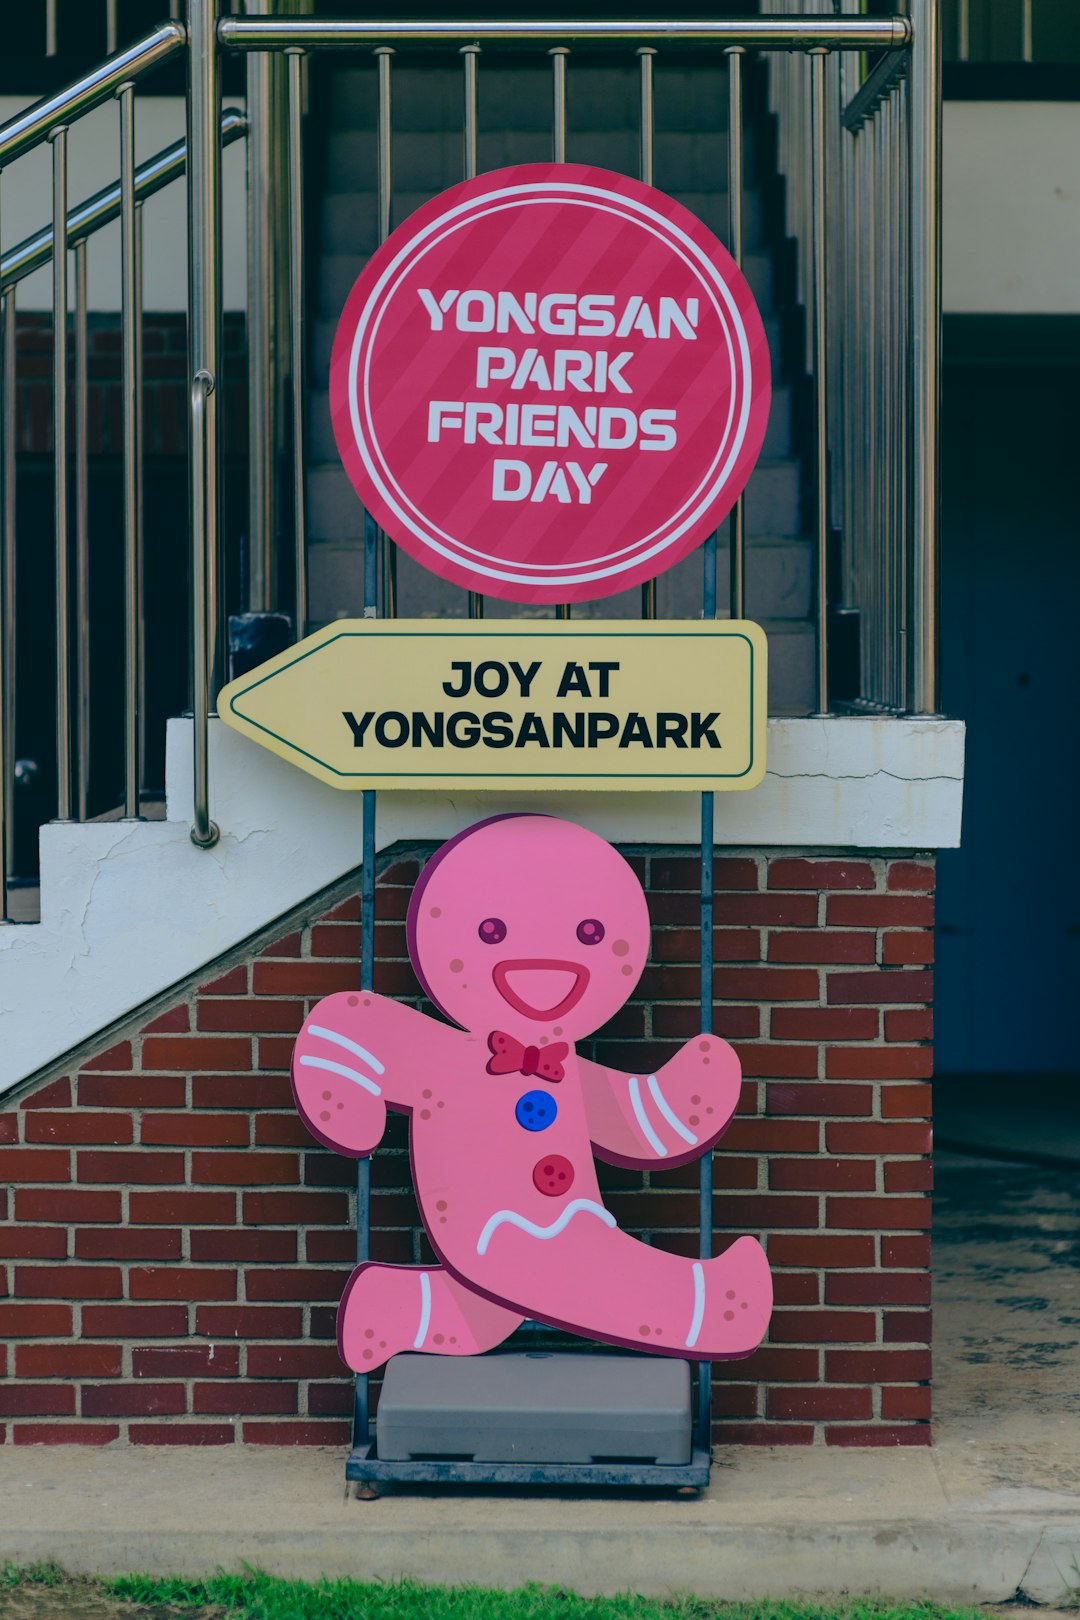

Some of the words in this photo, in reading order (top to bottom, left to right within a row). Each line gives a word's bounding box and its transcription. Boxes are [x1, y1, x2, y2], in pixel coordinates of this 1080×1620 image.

[418, 289, 698, 339] YONGSAN
[477, 347, 633, 393] PARK
[428, 401, 676, 451] FRIENDS
[492, 459, 608, 504] DAY
[443, 661, 542, 697] JOY
[557, 662, 619, 697] AT
[342, 711, 721, 748] YONGSANPARK
